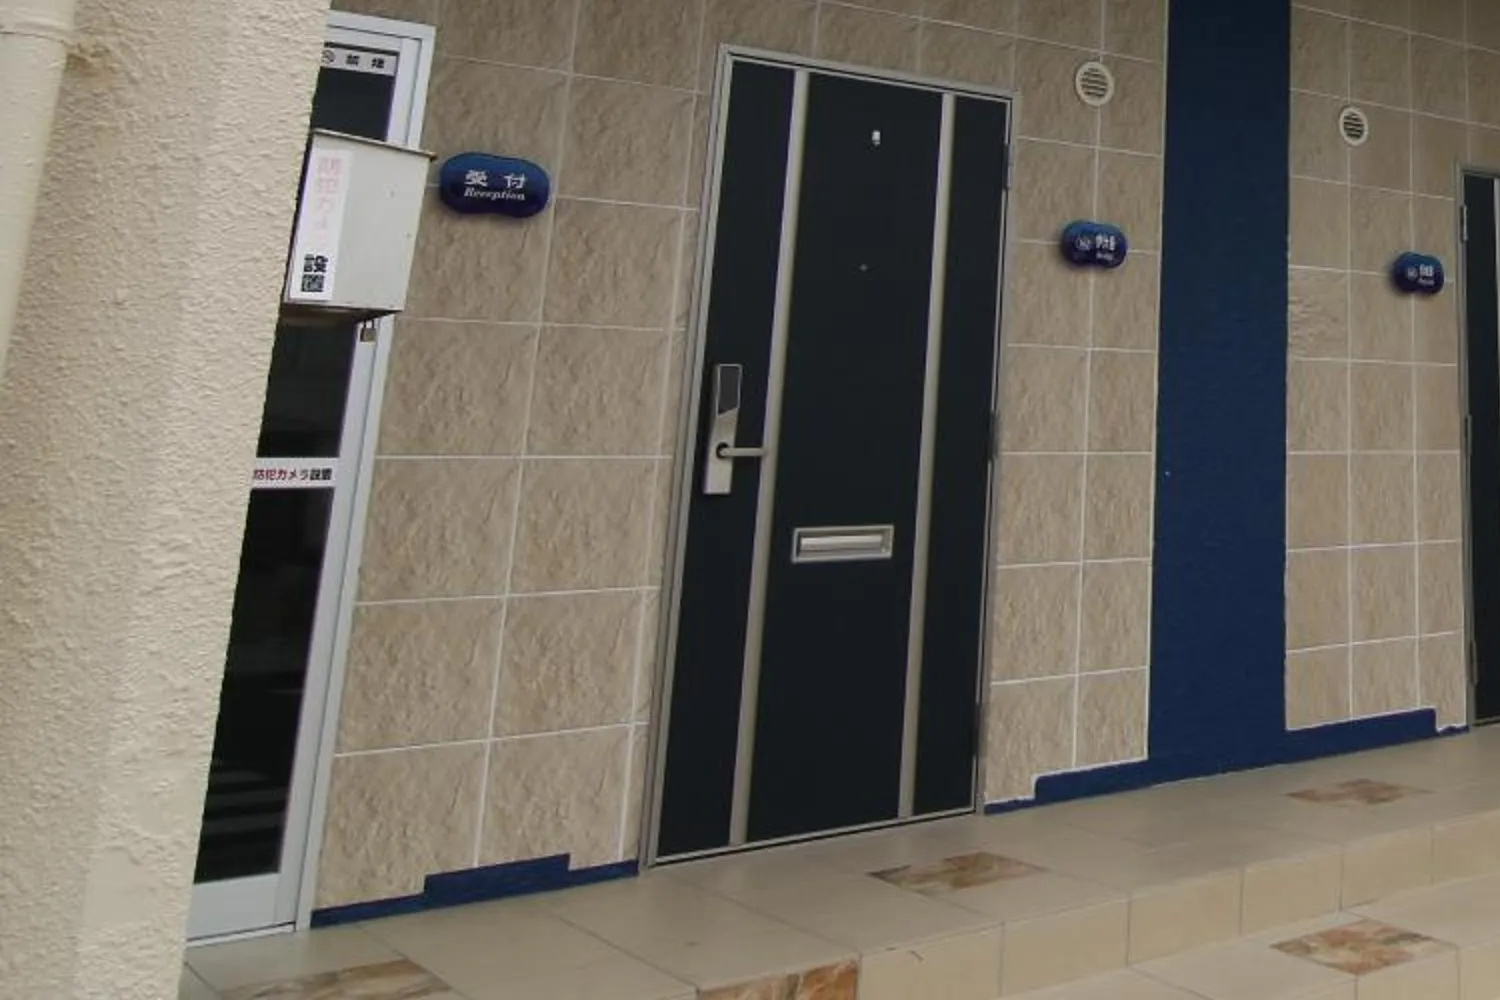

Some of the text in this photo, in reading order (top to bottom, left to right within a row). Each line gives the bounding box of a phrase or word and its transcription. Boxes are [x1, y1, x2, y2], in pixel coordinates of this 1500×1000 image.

[464, 169, 526, 189] 受付
[463, 187, 526, 201] Reception
[300, 157, 342, 293] 防犯カ設置
